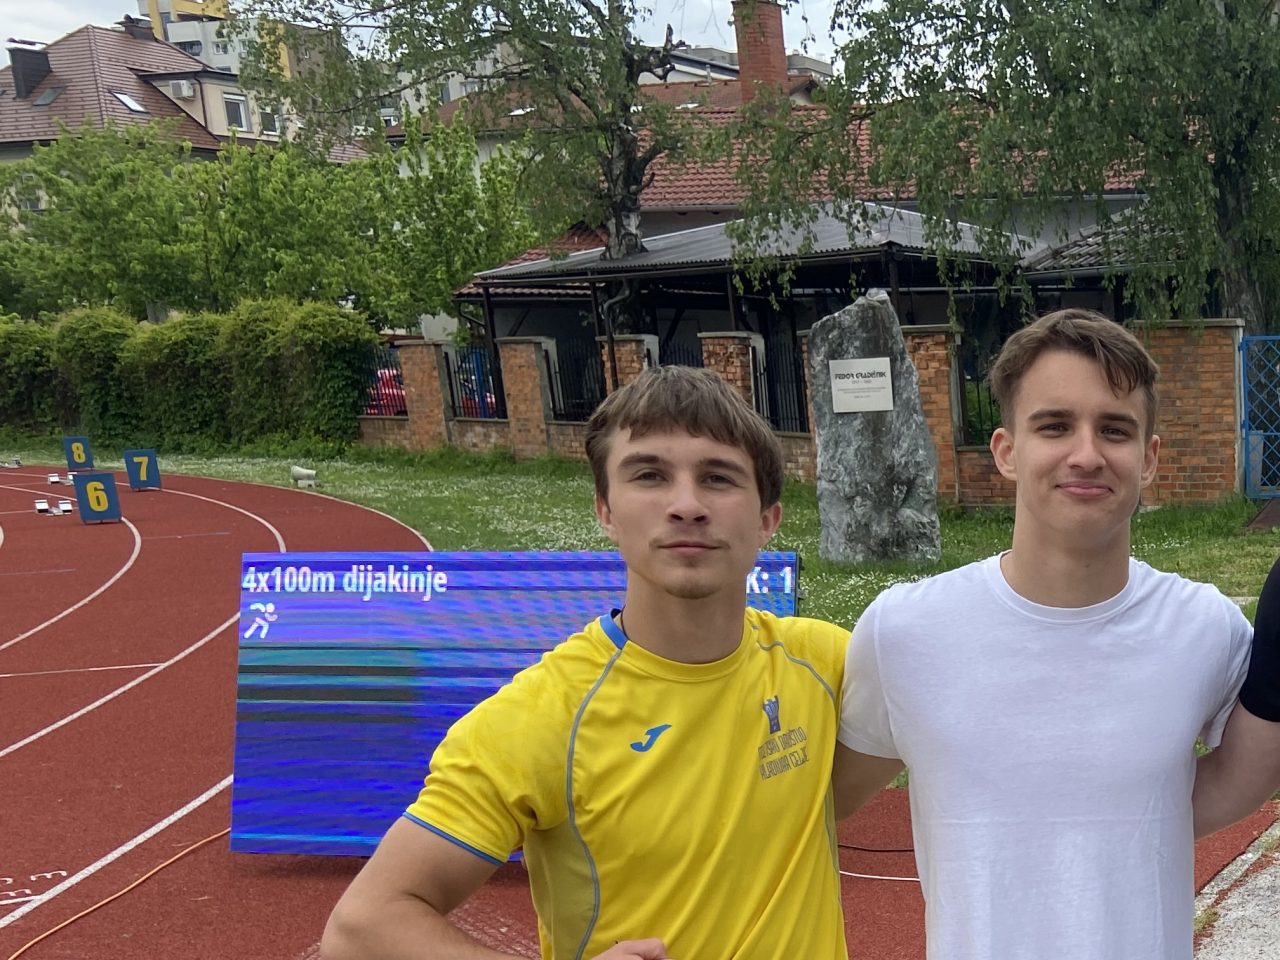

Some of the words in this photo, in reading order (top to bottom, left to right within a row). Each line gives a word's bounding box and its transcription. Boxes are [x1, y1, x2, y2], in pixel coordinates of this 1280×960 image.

[71, 442, 86, 464] 8
[133, 456, 149, 481] 7
[86, 481, 109, 512] 6
[242, 566, 335, 593] 4x100m
[343, 564, 448, 601] dijakinje
[780, 566, 792, 594] 1
